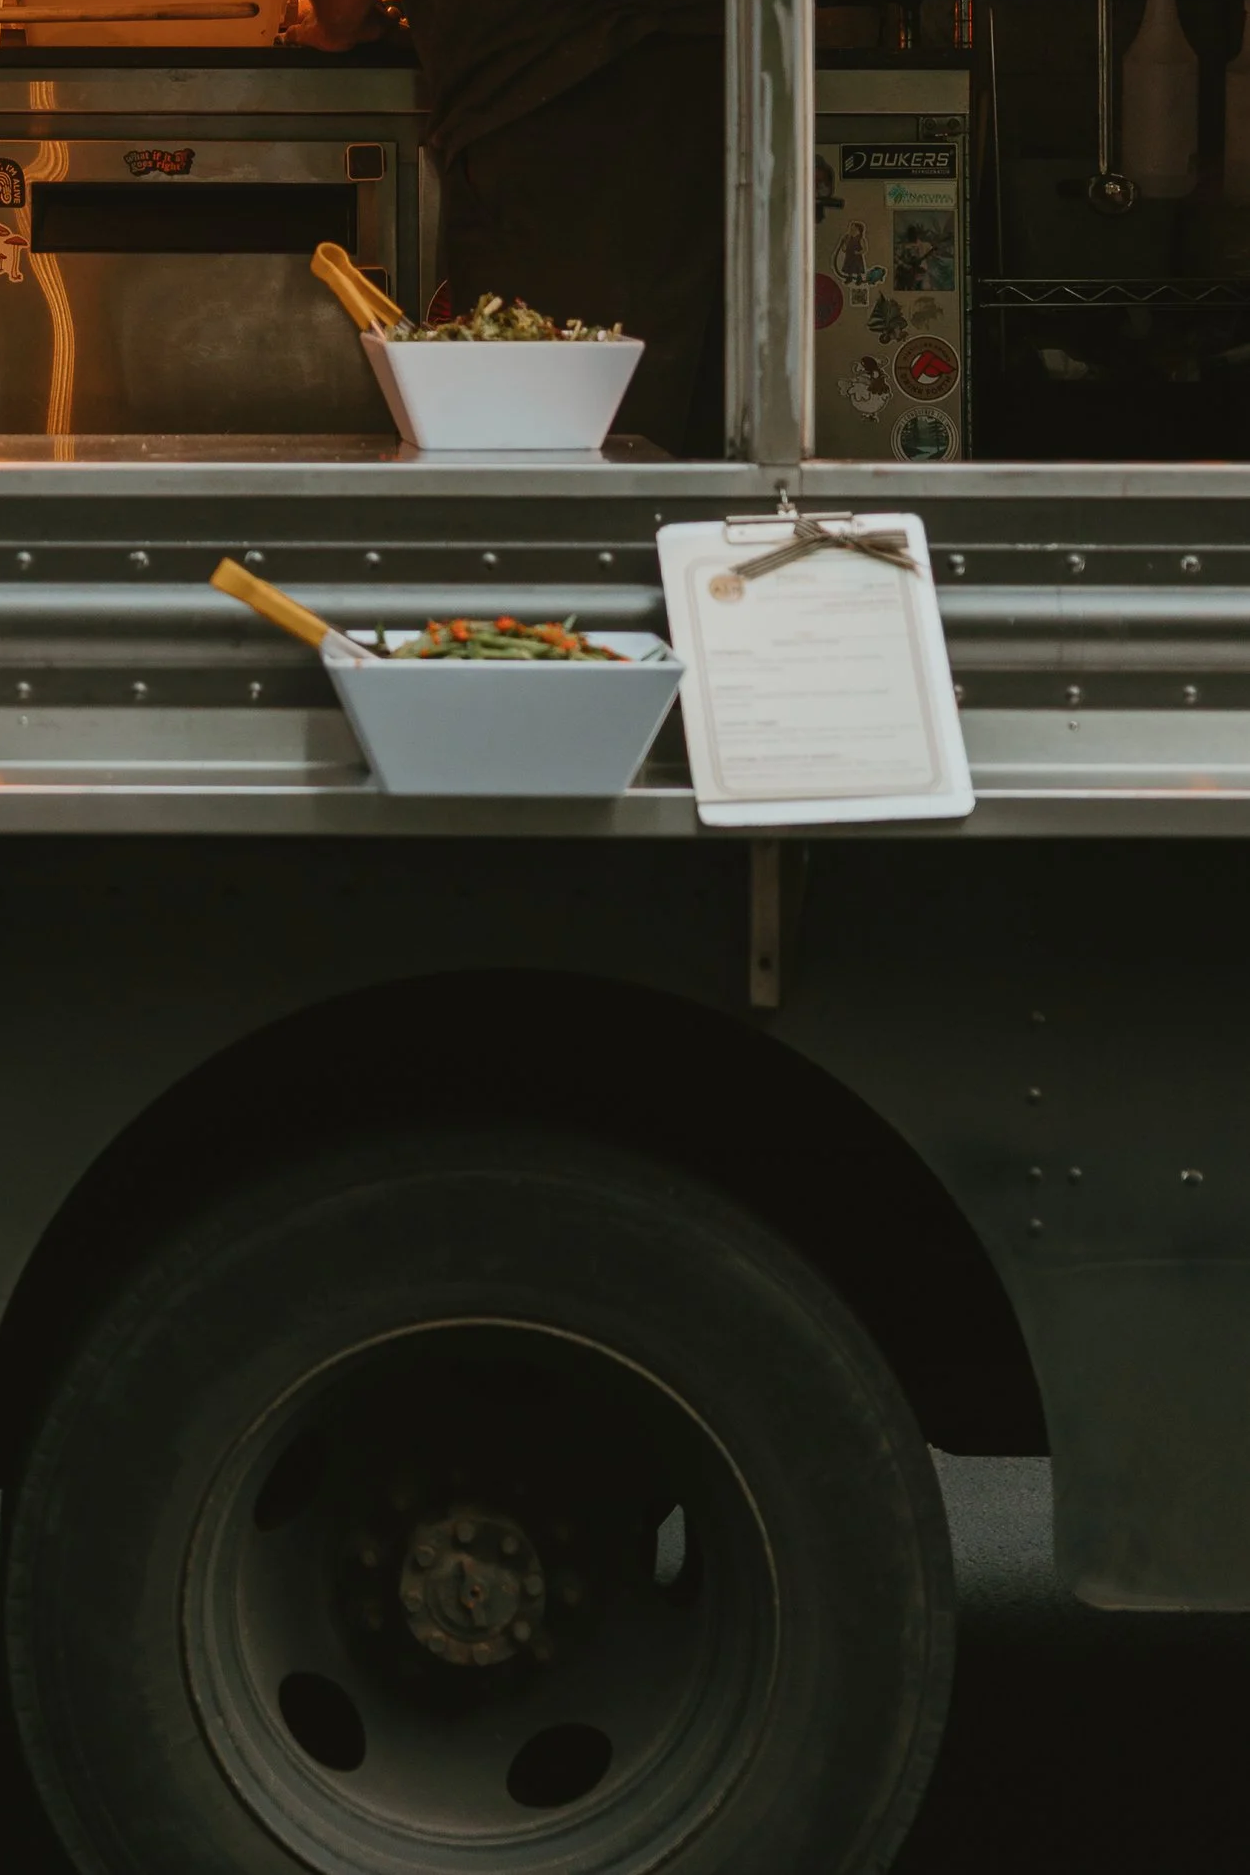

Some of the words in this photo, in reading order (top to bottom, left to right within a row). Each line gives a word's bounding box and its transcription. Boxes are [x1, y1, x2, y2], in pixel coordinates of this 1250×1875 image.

[125, 151, 150, 162] what
[152, 151, 162, 160] if
[869, 152, 950, 167] DUKERS
[131, 160, 153, 172] goes
[12, 178, 21, 204] ALIVE
